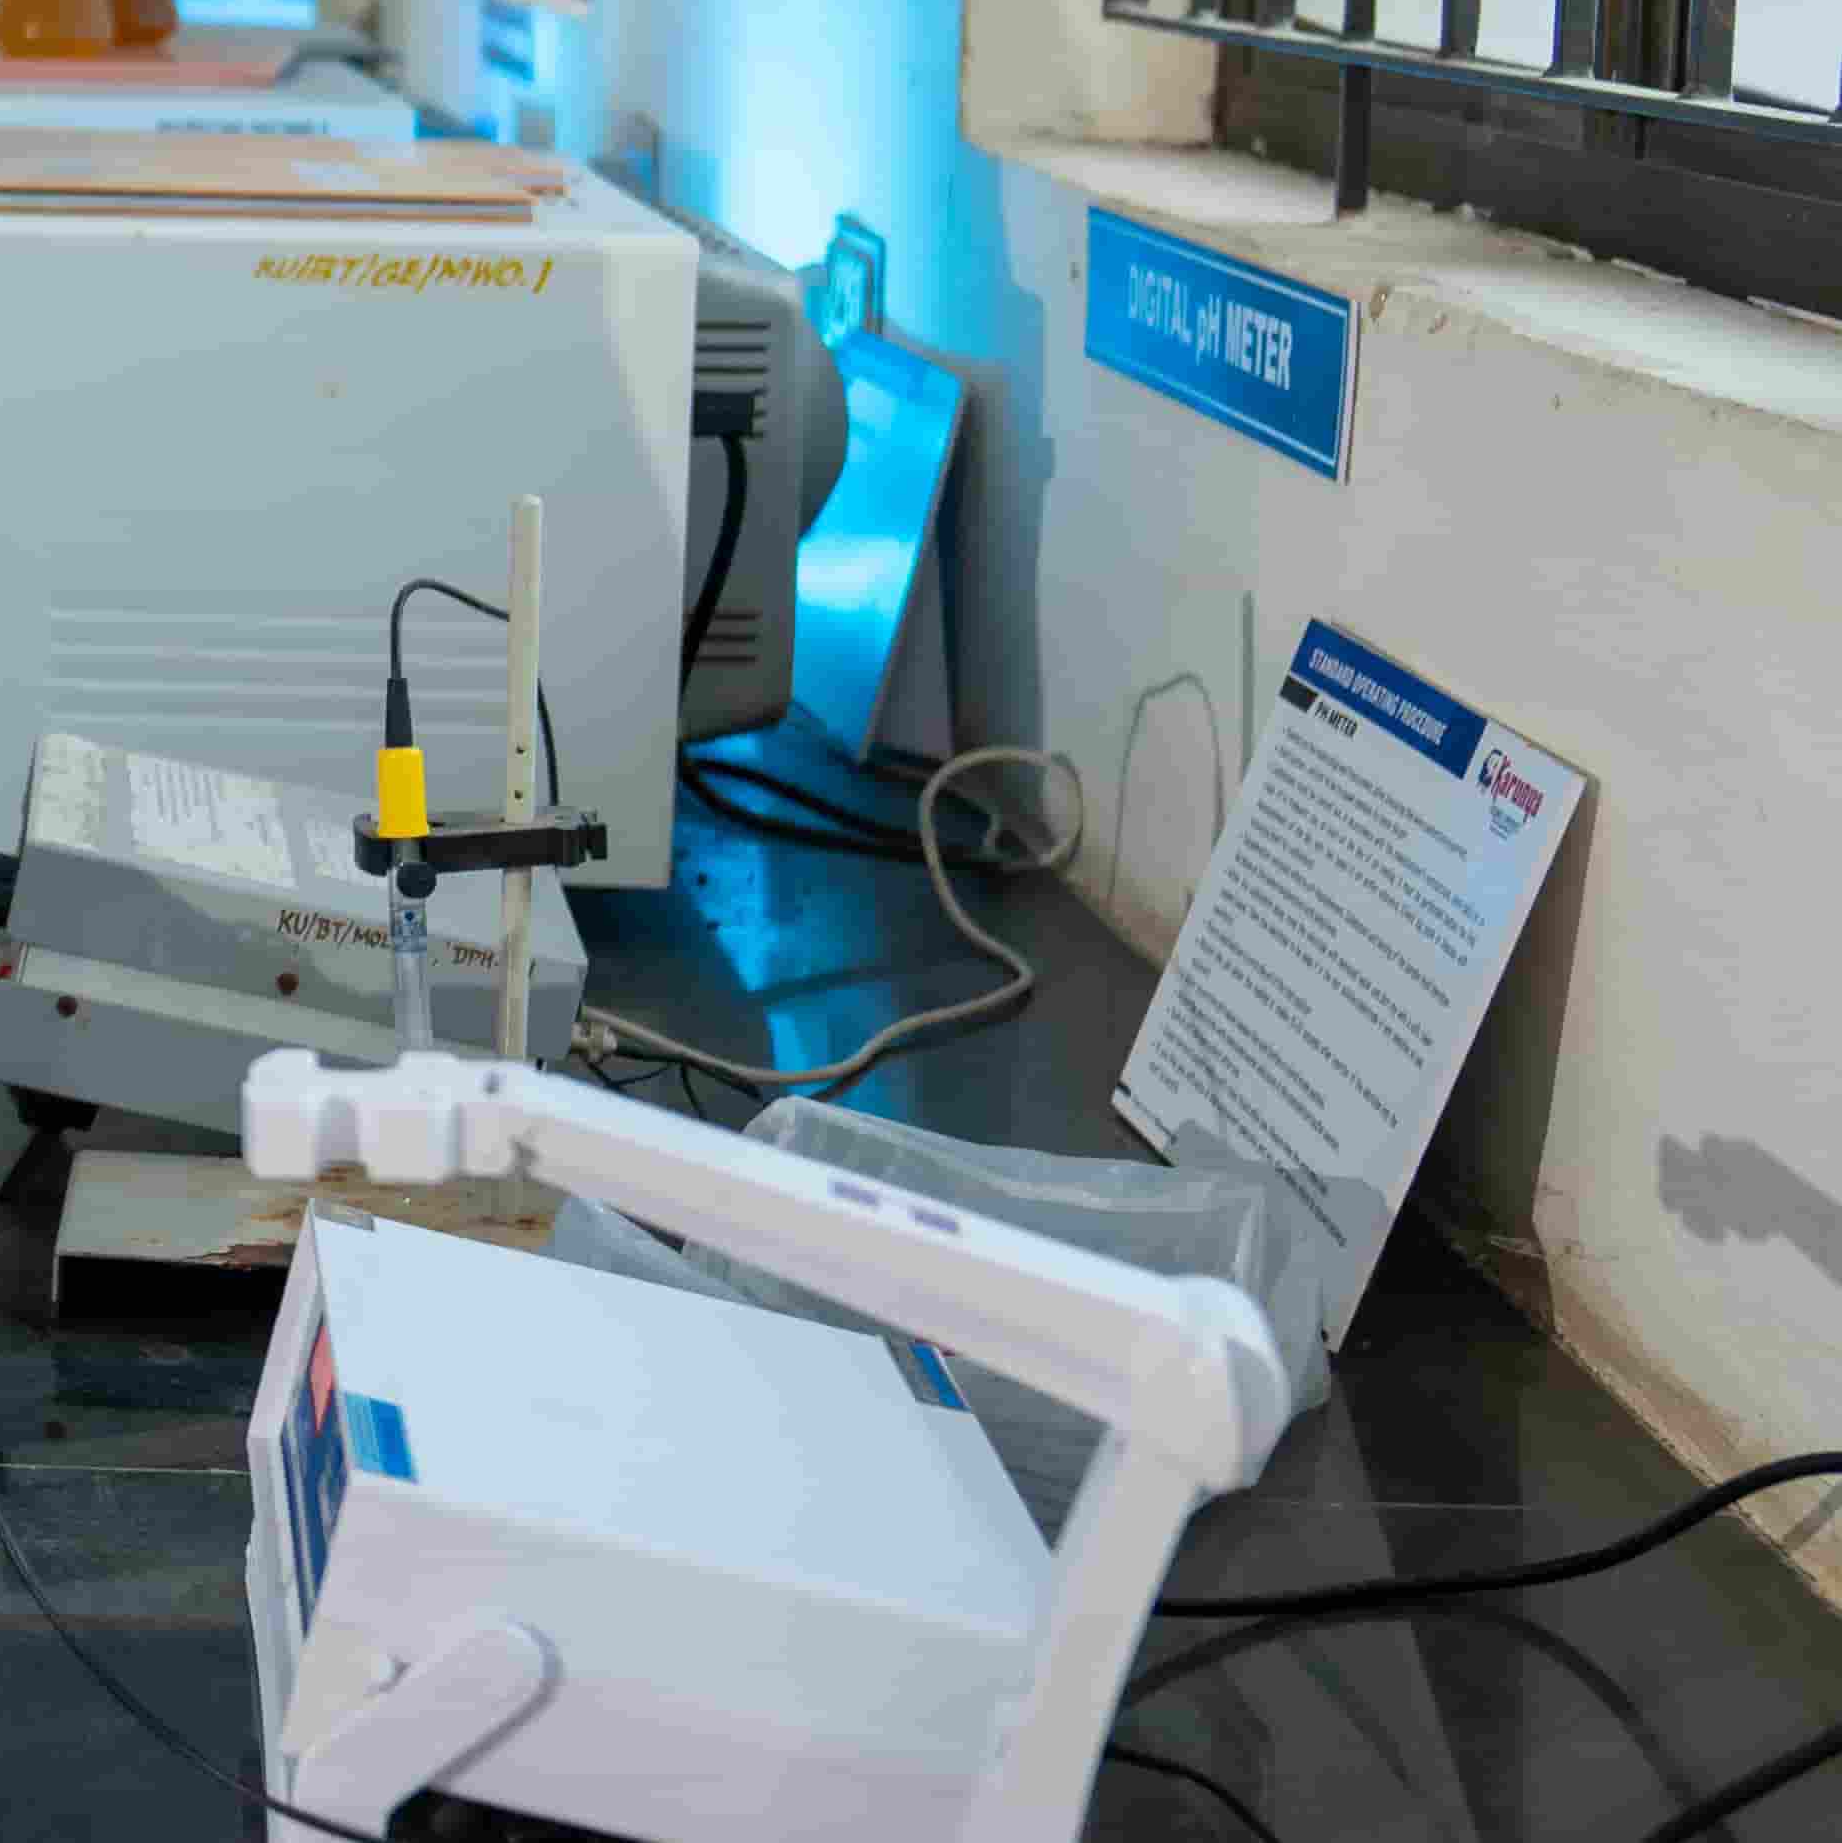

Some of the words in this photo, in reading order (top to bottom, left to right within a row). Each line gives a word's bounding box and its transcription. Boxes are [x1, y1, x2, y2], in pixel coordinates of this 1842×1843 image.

[1128, 263, 1192, 345] DIGITAL
[1196, 293, 1223, 367] pH
[1225, 301, 1292, 391] METER
[1309, 647, 1356, 691] STANDARD
[1351, 673, 1400, 720] OPERATING
[1395, 699, 1448, 746] PROCEDURE
[1328, 709, 1359, 739] METER
